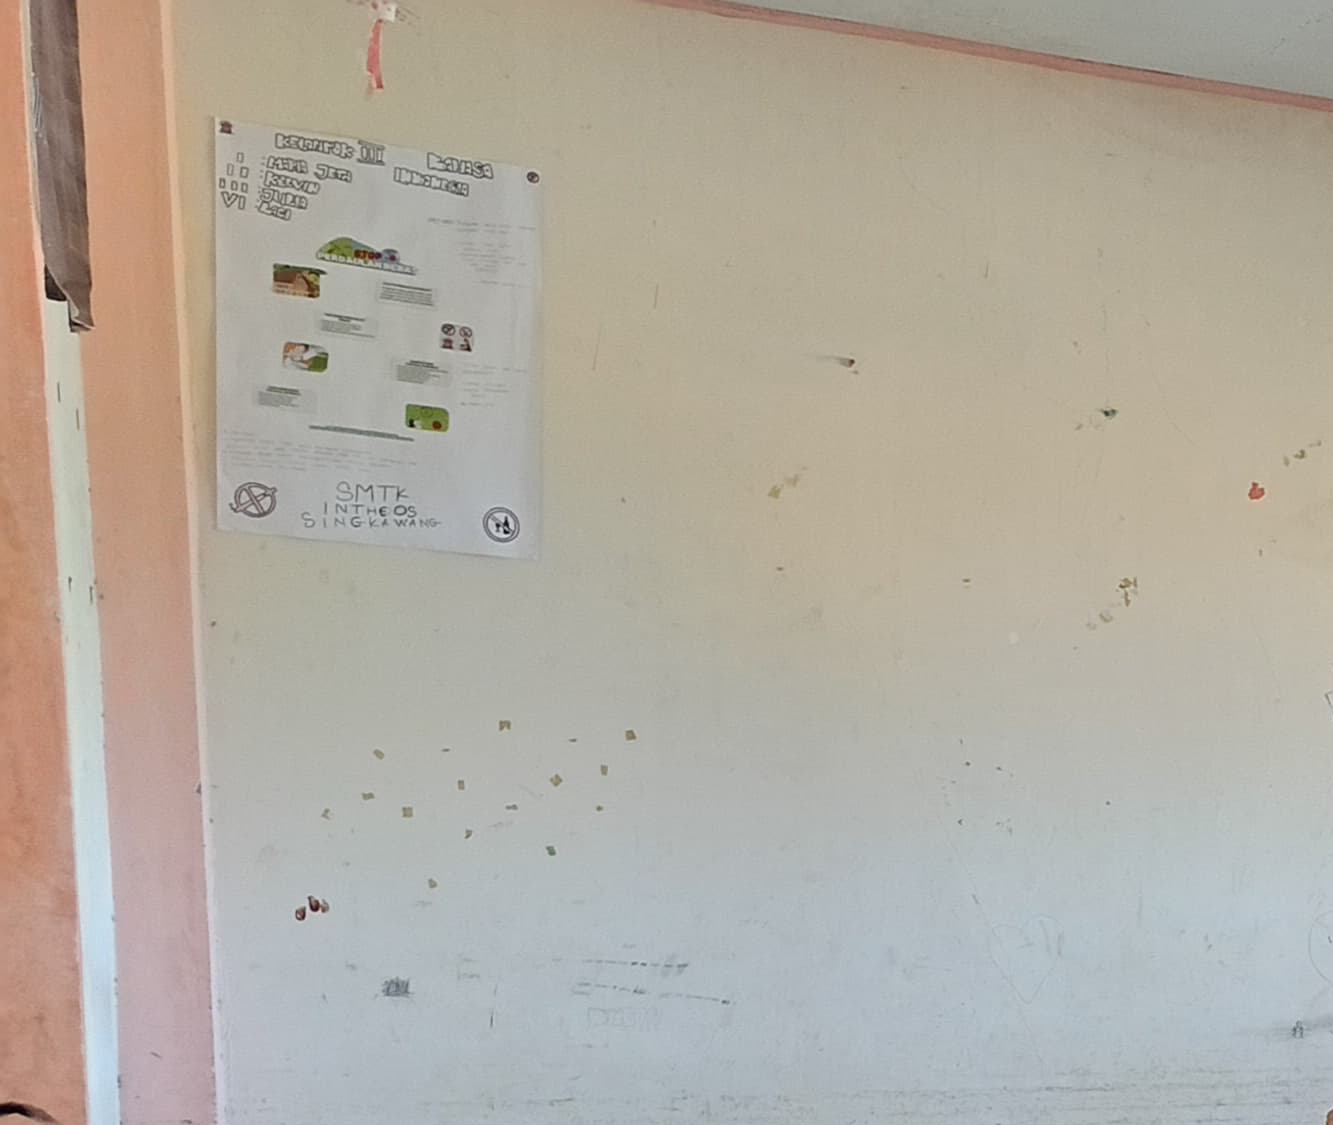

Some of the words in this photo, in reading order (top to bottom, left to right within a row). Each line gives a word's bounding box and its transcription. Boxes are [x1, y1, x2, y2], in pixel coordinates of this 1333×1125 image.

[336, 481, 409, 502] SMTK
[323, 502, 418, 518] INTHEOS
[300, 511, 443, 529] SINGKAWANG
